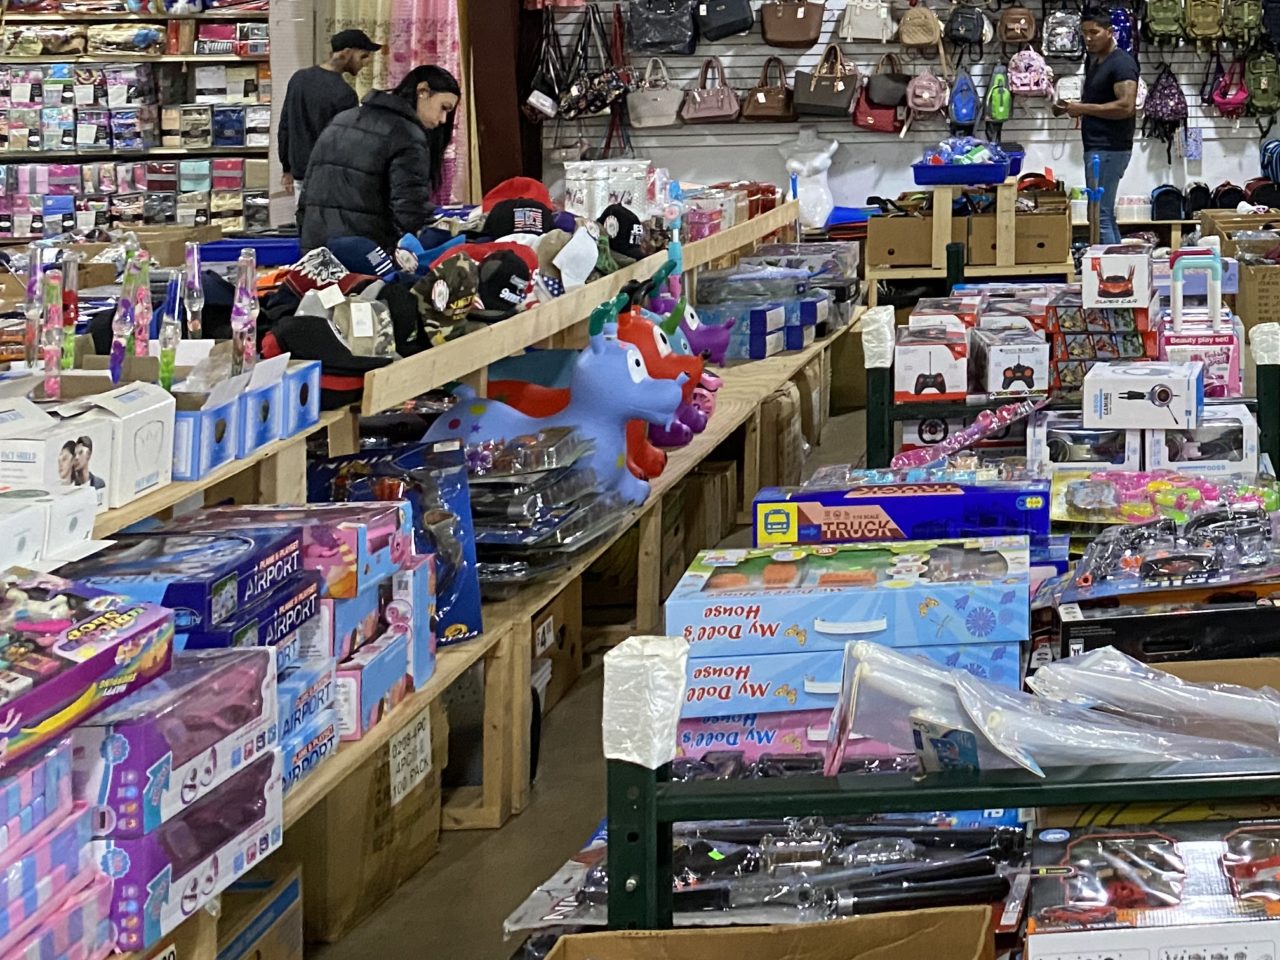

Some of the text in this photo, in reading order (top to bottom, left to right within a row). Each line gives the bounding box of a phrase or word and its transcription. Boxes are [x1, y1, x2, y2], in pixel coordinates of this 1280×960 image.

[1198, 337, 1216, 345] play
[823, 520, 892, 538] TRUCK
[244, 550, 300, 601] AIRPORT
[265, 593, 318, 647] AIRPORT
[704, 605, 761, 620] House
[683, 621, 780, 642] My Doll's
[693, 665, 751, 680] House
[738, 681, 770, 698] My
[282, 681, 332, 737] AIRPORT
[682, 727, 776, 748] My Doll's
